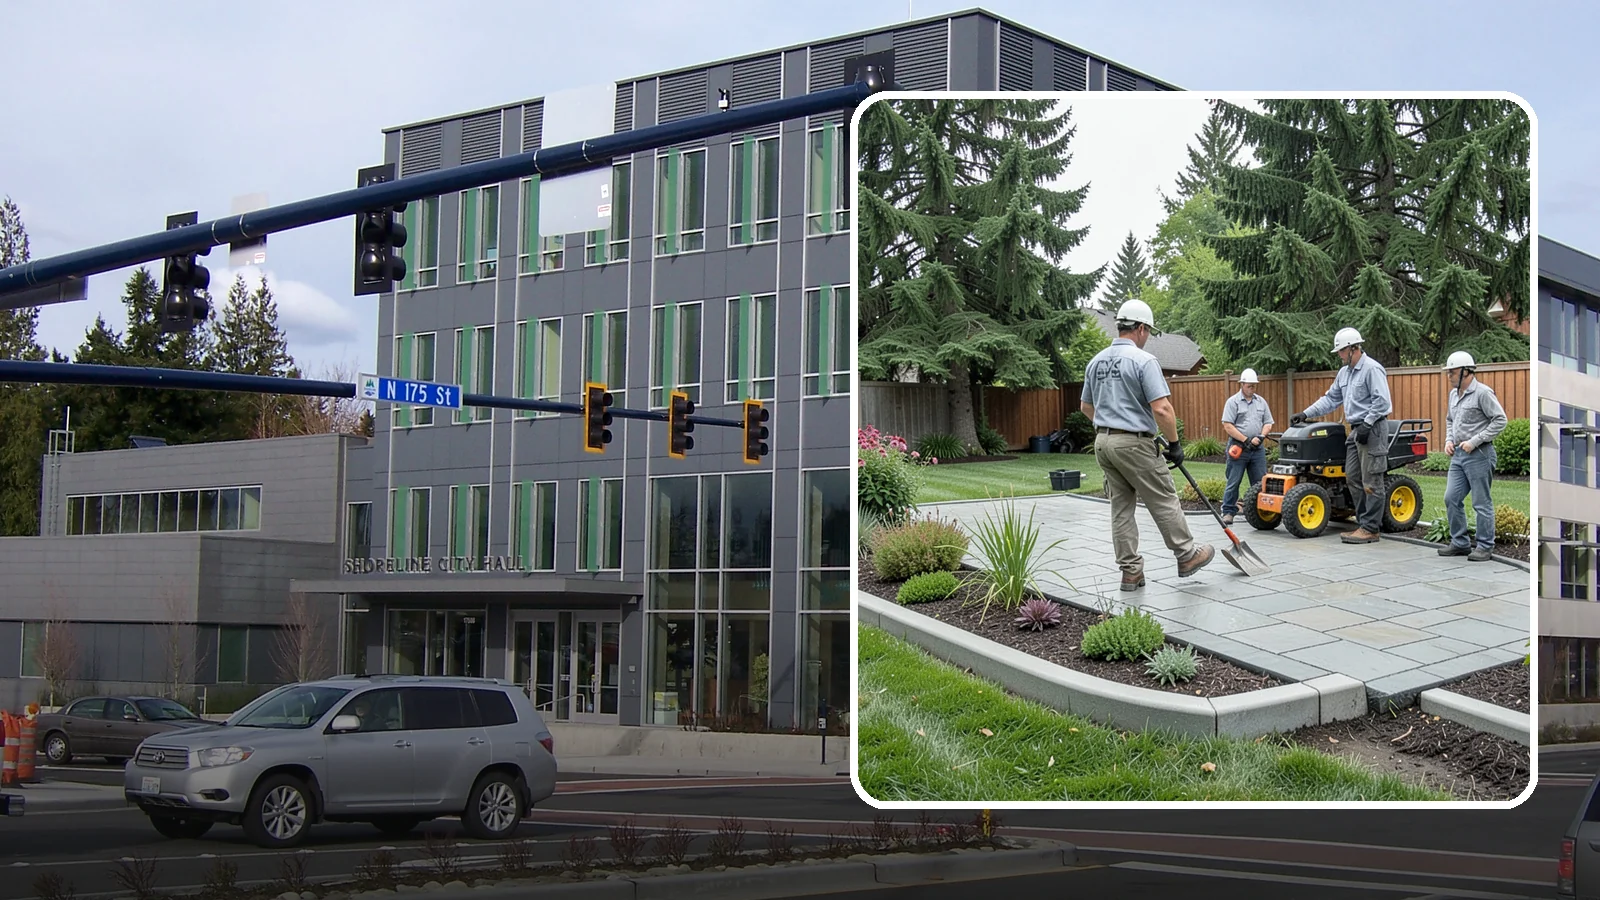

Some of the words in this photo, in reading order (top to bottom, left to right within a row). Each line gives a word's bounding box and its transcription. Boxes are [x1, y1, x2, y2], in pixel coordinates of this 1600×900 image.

[387, 380, 396, 400] N
[405, 382, 427, 403] 175
[436, 386, 451, 406] St
[343, 557, 431, 573] SHORELINE
[439, 556, 475, 572] CITY
[484, 555, 526, 571] HALL
